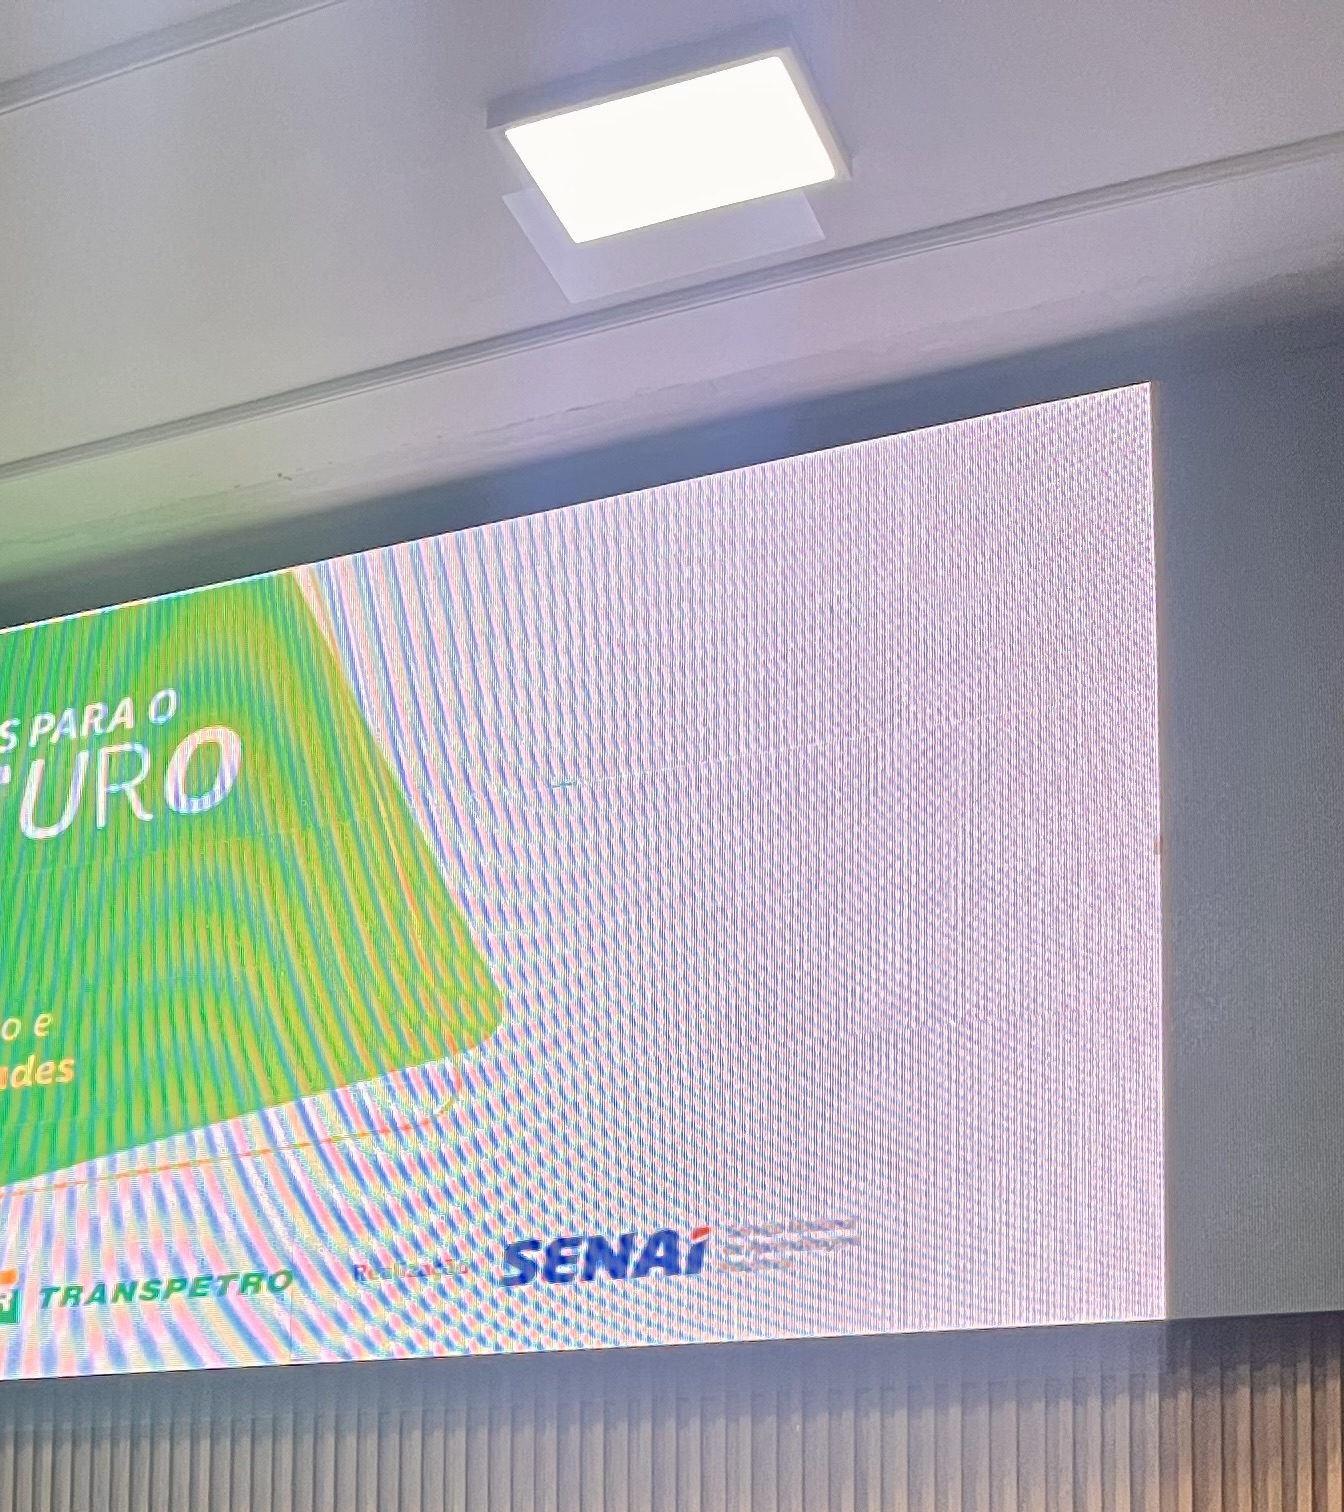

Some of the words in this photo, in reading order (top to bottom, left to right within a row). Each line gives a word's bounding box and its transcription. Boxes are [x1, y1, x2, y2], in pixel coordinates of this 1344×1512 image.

[29, 696, 135, 747] PARA
[148, 688, 178, 725] O
[33, 1012, 53, 1037] e
[40, 1269, 294, 1308] TRANSPETRO
